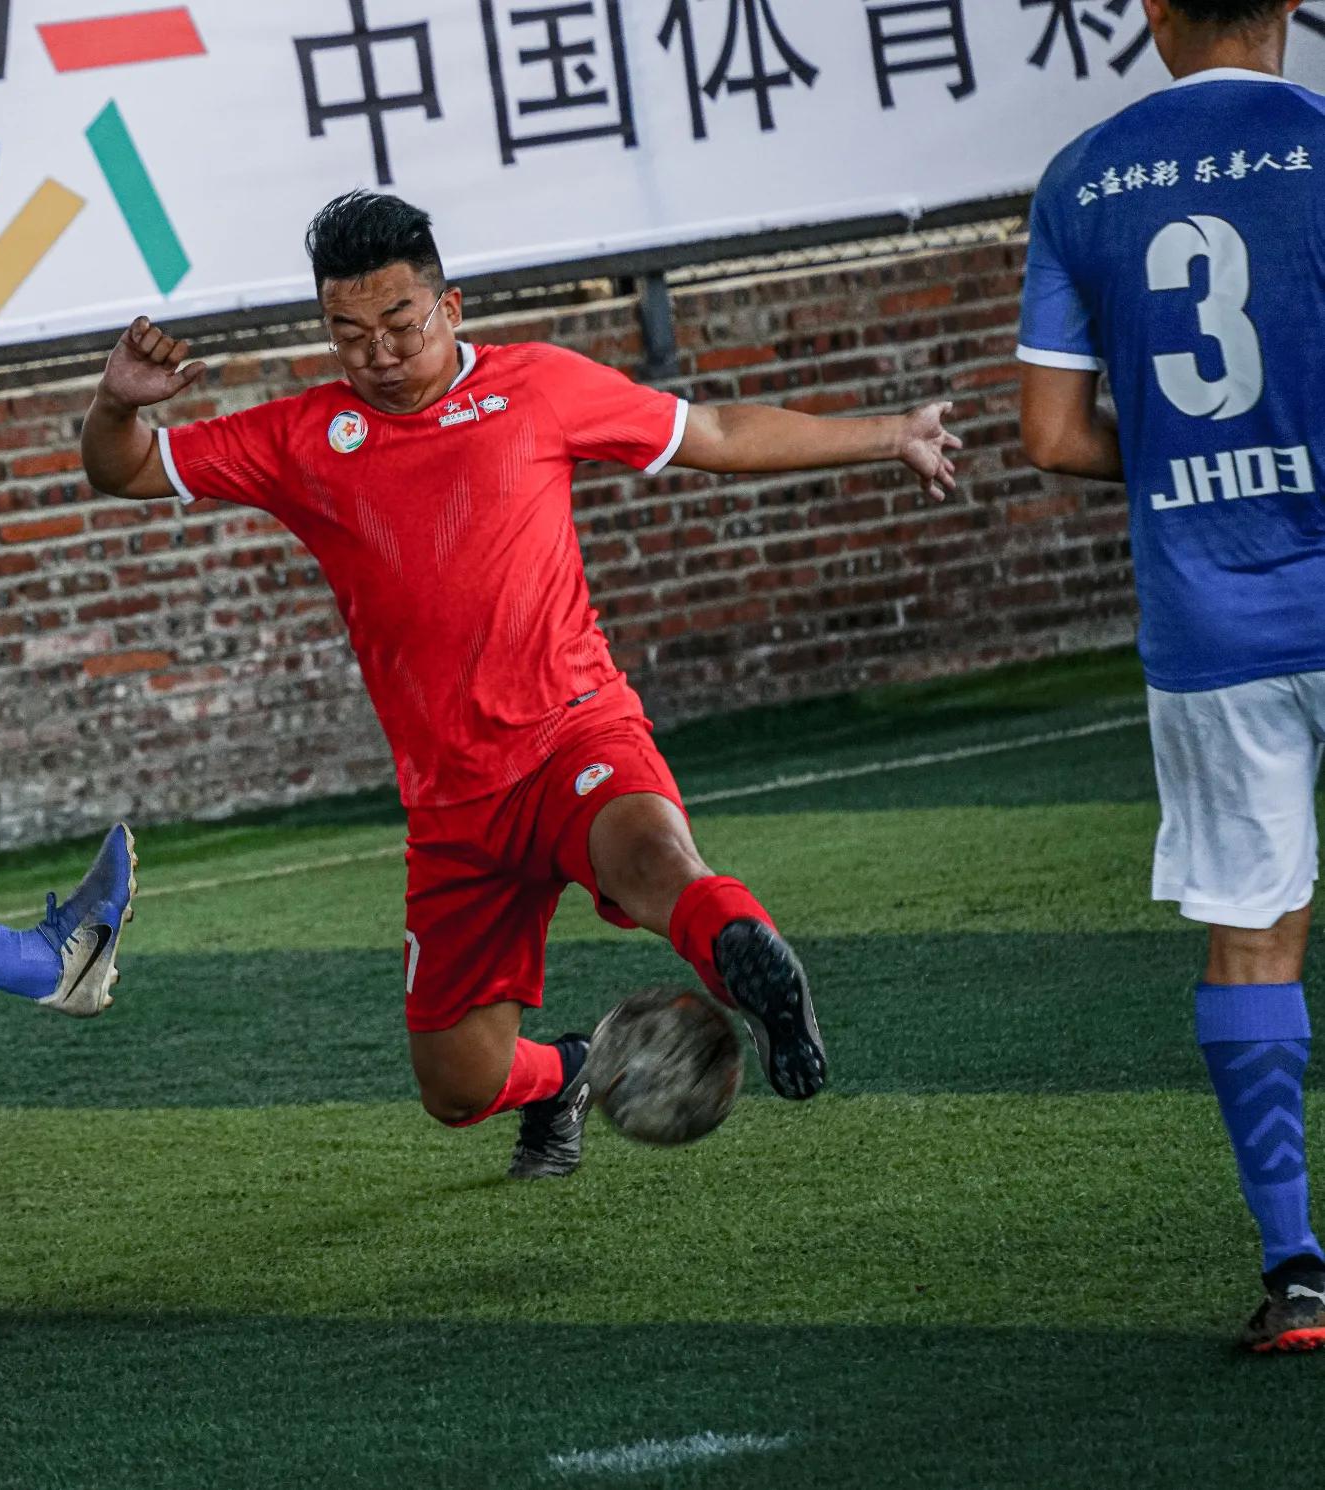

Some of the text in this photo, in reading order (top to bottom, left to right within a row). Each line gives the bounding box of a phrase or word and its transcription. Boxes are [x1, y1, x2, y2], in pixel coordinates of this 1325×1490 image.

[292, 0, 1325, 184] 中国体育
[1077, 145, 1313, 206] 公益体彩 乐善人生
[1146, 215, 1264, 420] 3
